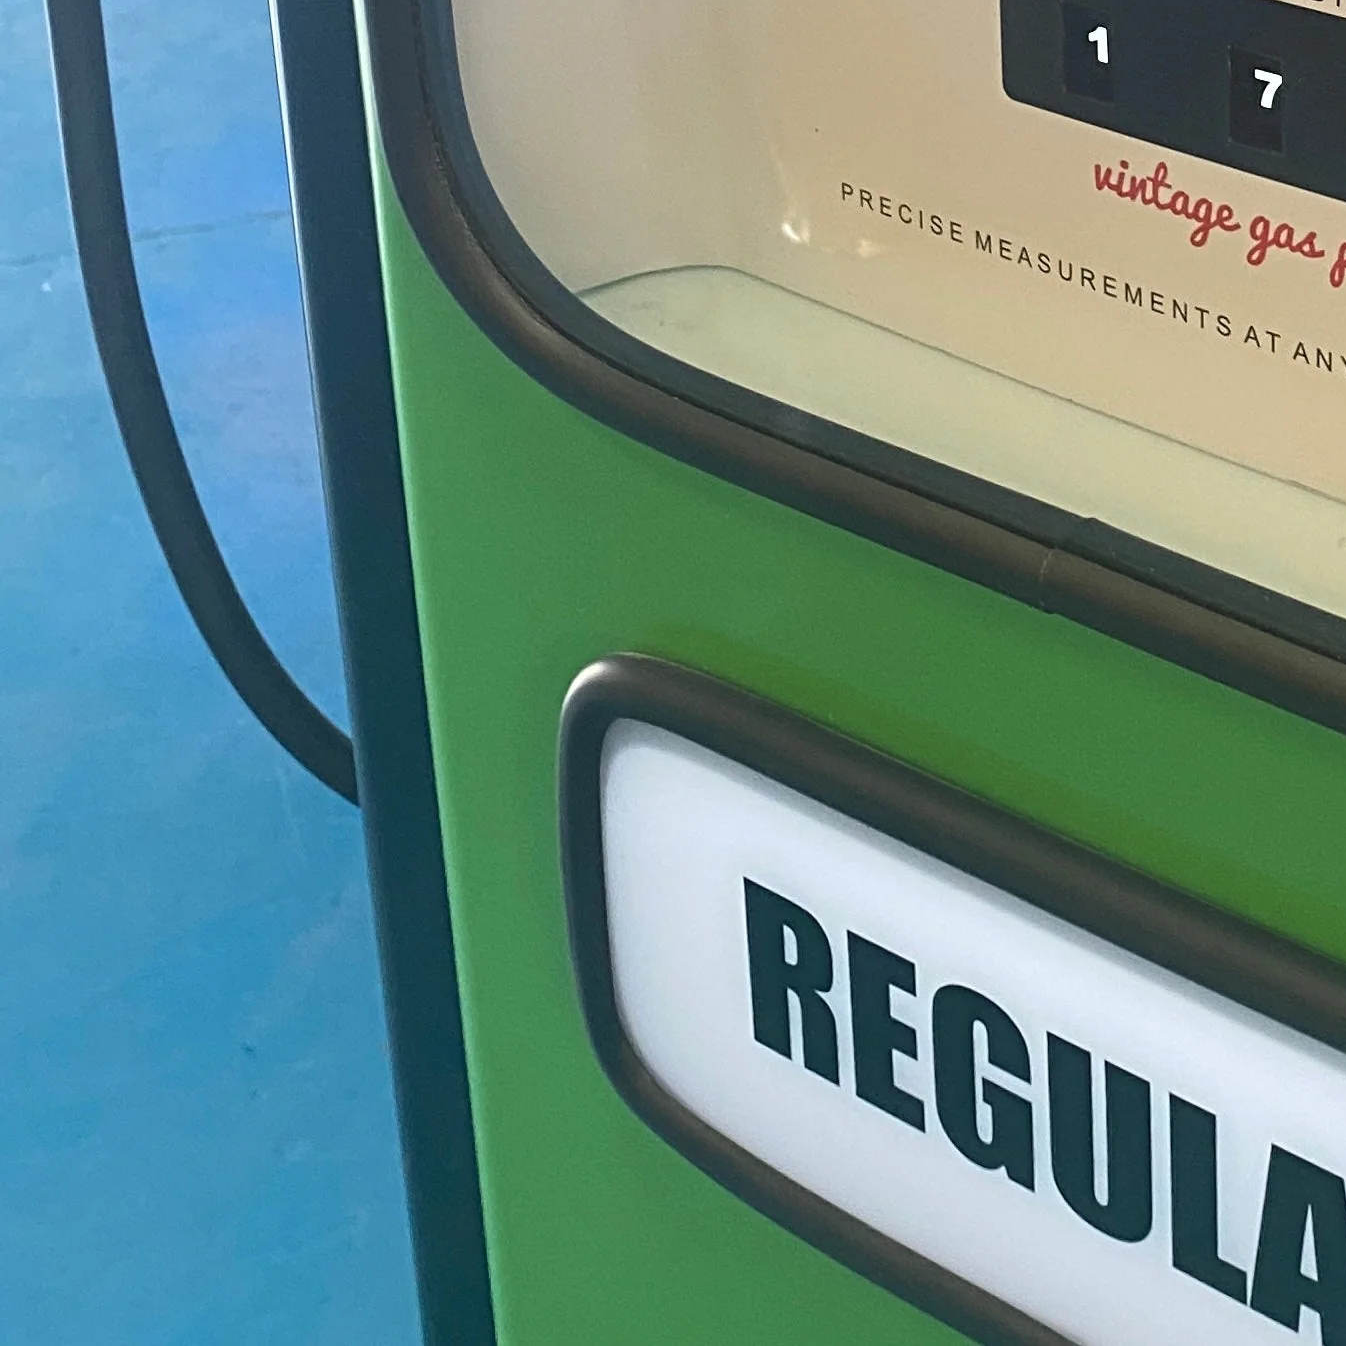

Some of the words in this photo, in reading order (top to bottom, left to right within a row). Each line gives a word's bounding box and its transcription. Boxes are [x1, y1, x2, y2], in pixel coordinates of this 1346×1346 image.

[840, 180, 965, 245] PRECISE
[974, 228, 1233, 338] MEASUREMENTS
[1242, 324, 1283, 355] AT
[1093, 161, 1242, 248] vintage
[1247, 214, 1327, 267] gas
